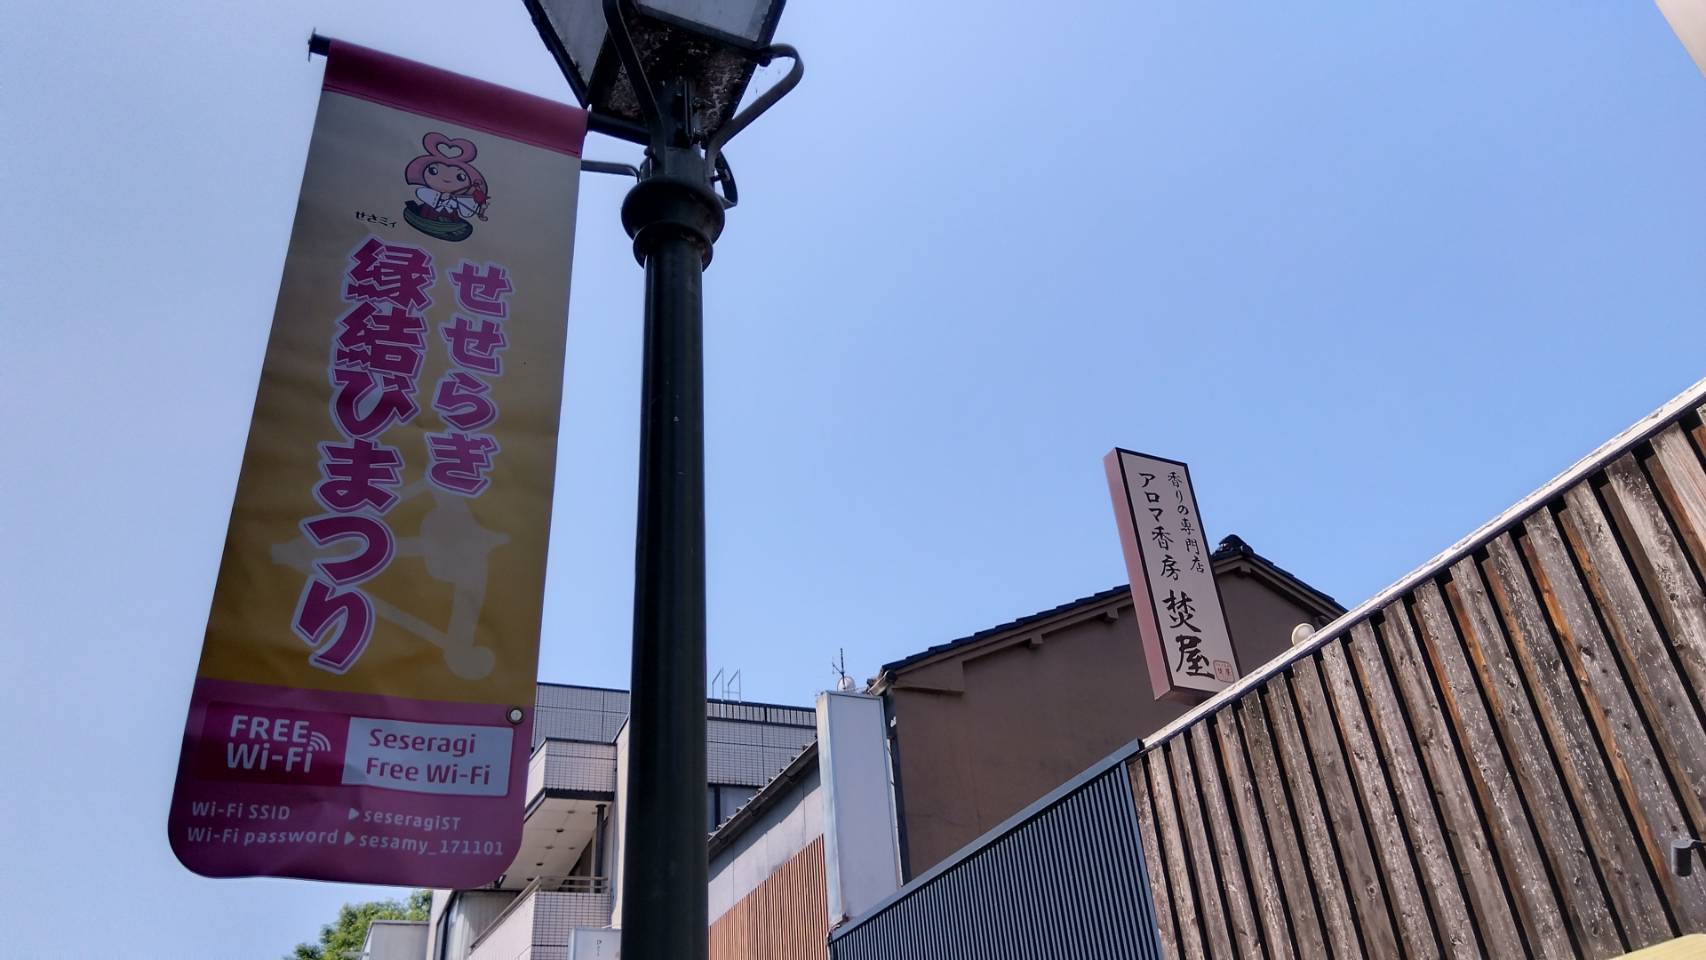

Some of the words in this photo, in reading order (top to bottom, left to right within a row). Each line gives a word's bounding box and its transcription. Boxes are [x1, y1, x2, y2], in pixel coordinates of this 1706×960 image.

[426, 262, 512, 496] せせらぎ
[293, 236, 435, 673] 縁結びまつり
[1167, 471, 1205, 574] 香りの専門店
[1138, 472, 1181, 582] アロマ香房
[1162, 589, 1216, 680] 焚屋
[229, 714, 310, 743] FREE
[368, 728, 477, 758] Seseragi
[226, 742, 313, 773] Wi-Fi
[365, 757, 419, 782] Free
[426, 761, 491, 785] Wi-Fi
[192, 801, 243, 818] Wi-Fi
[249, 804, 290, 820] SSID
[363, 810, 461, 831] seseragiST
[187, 827, 239, 844] Wi-Fi
[244, 828, 339, 847] password
[359, 834, 504, 856] sesamy_171101
